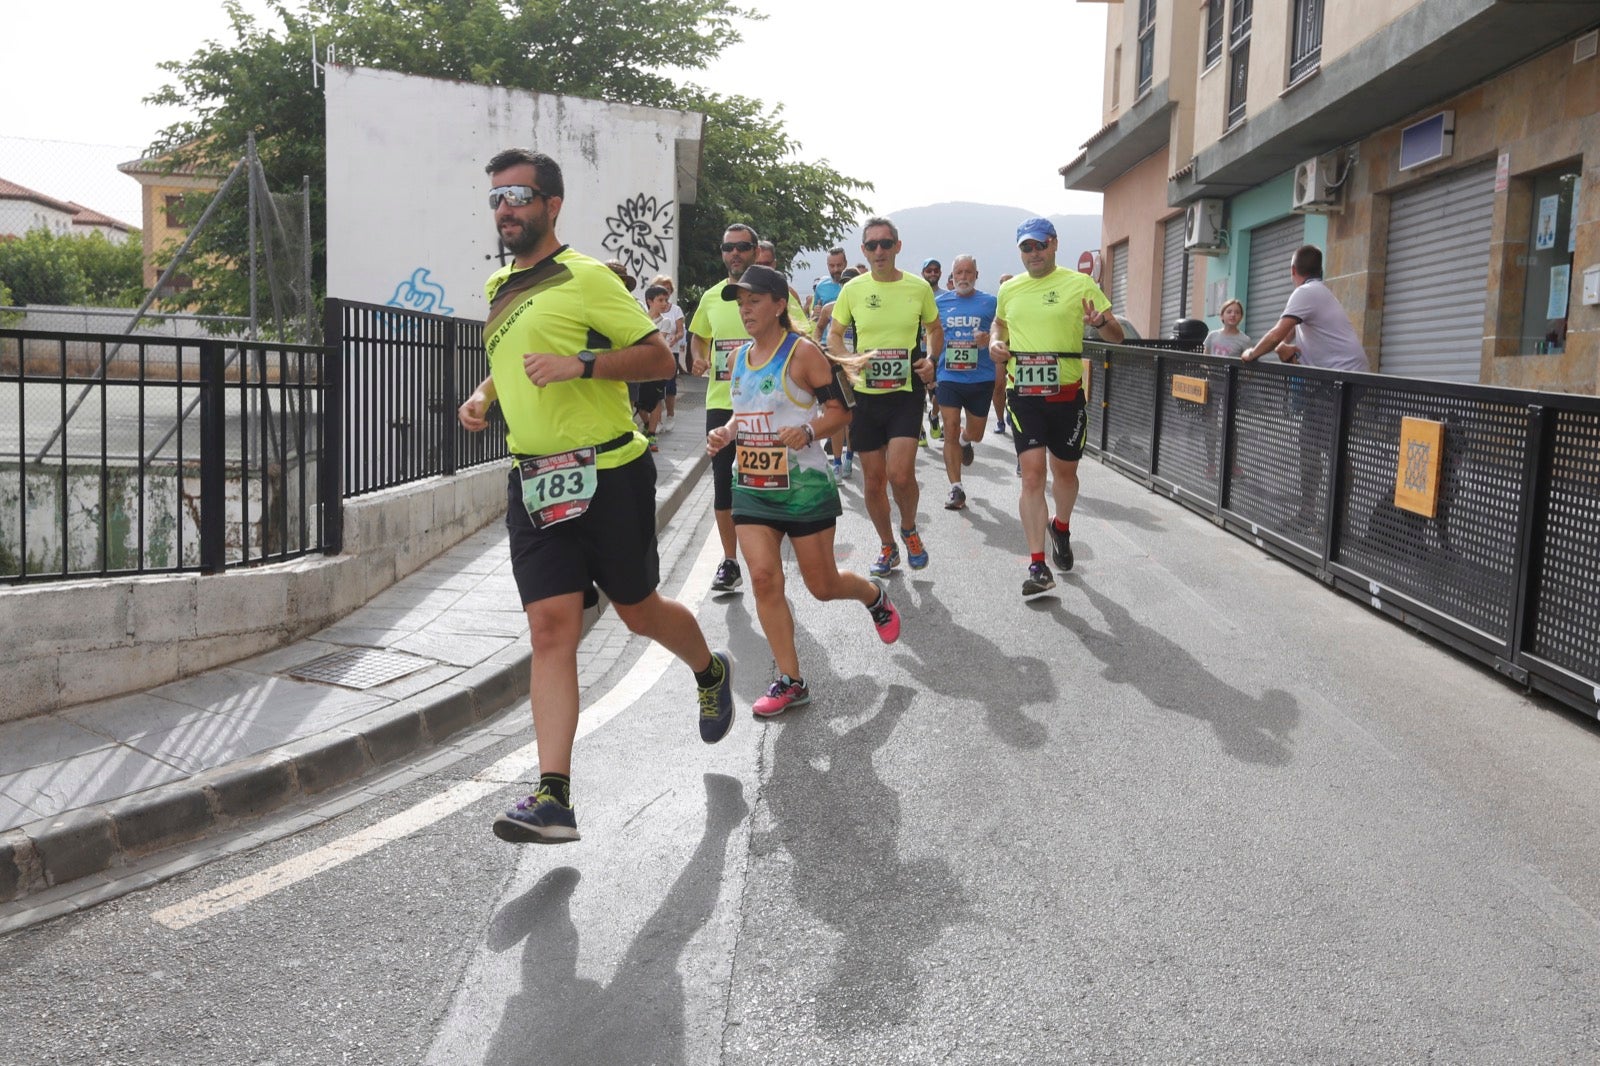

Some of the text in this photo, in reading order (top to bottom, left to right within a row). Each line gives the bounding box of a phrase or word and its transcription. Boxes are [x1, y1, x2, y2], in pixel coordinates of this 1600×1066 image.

[946, 315, 982, 329] SEUR
[954, 349, 969, 361] 25
[871, 361, 903, 377] 992
[1016, 366, 1058, 383] 1115
[741, 450, 784, 471] 2297
[535, 471, 585, 502] 183
